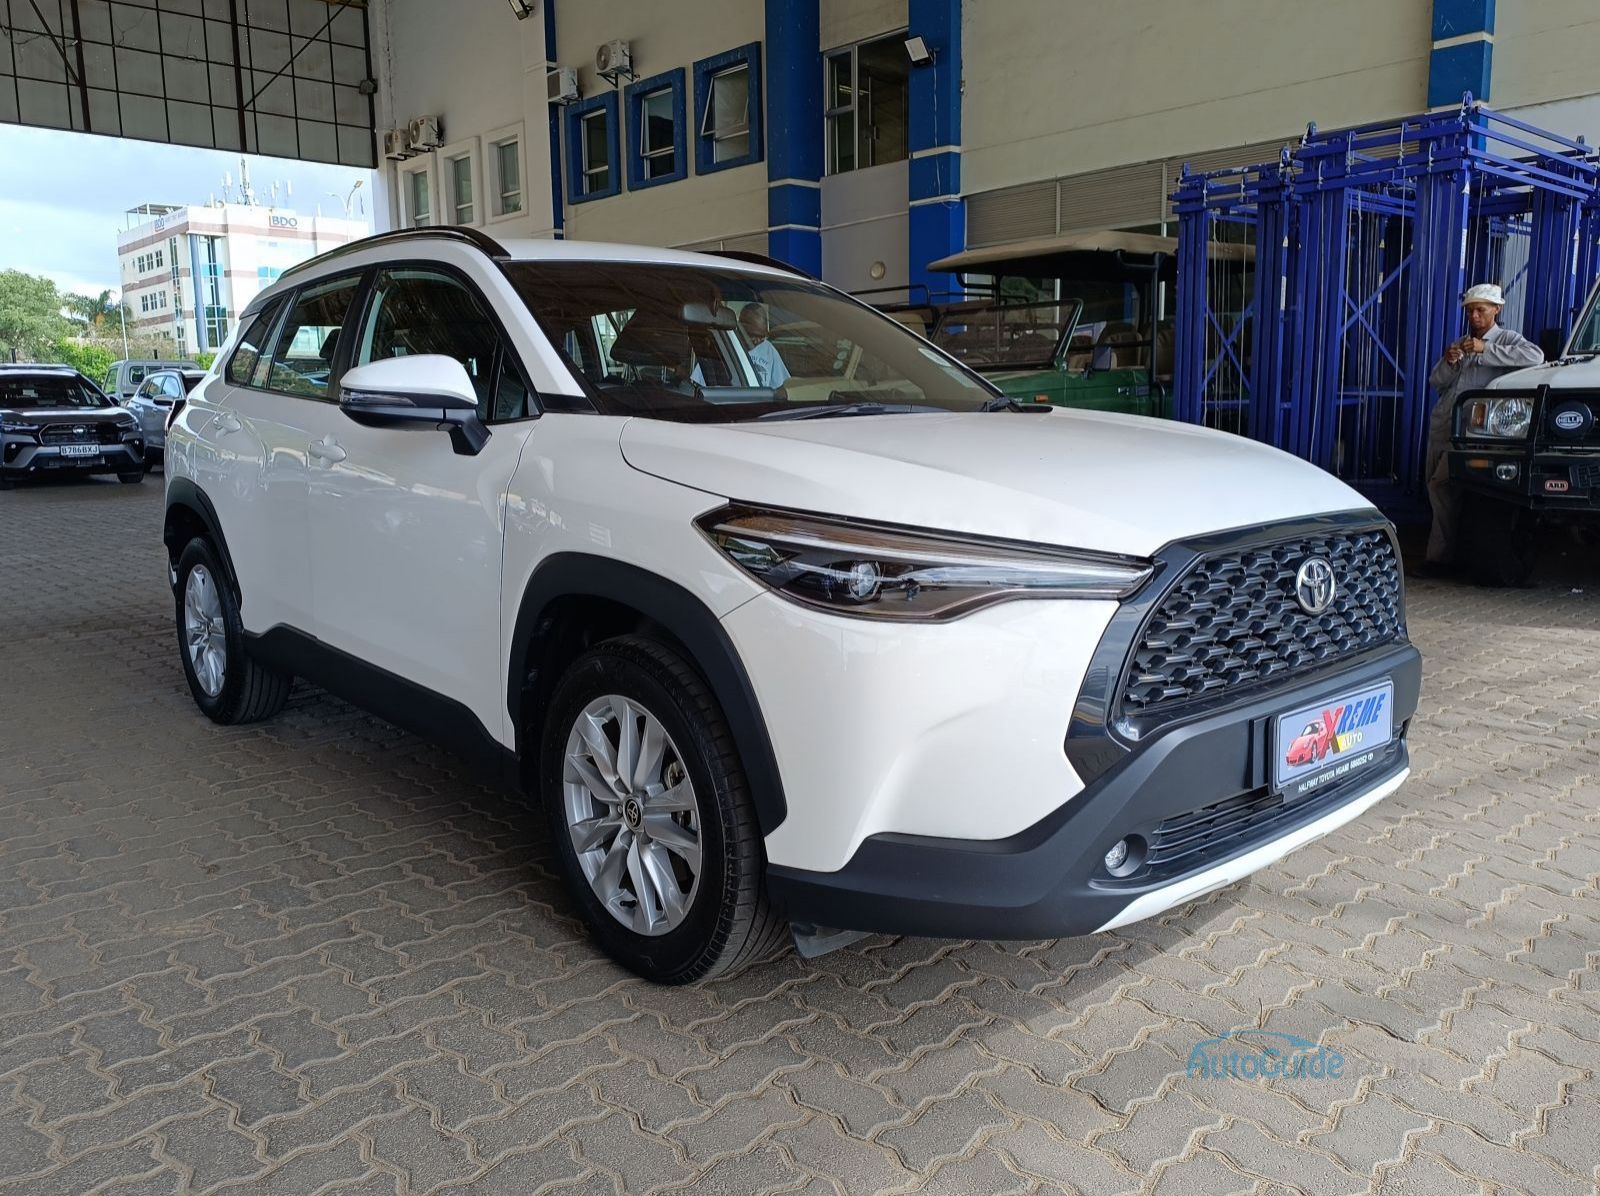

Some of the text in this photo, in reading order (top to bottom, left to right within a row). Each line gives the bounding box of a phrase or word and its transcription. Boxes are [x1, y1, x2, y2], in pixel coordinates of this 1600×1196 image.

[154, 217, 165, 229] BDO
[272, 215, 298, 228] BDO
[1317, 693, 1386, 759] XREME
[1341, 731, 1363, 748] AUTO
[1298, 776, 1319, 793] HALFWAY
[1318, 769, 1336, 784] TOYOTA
